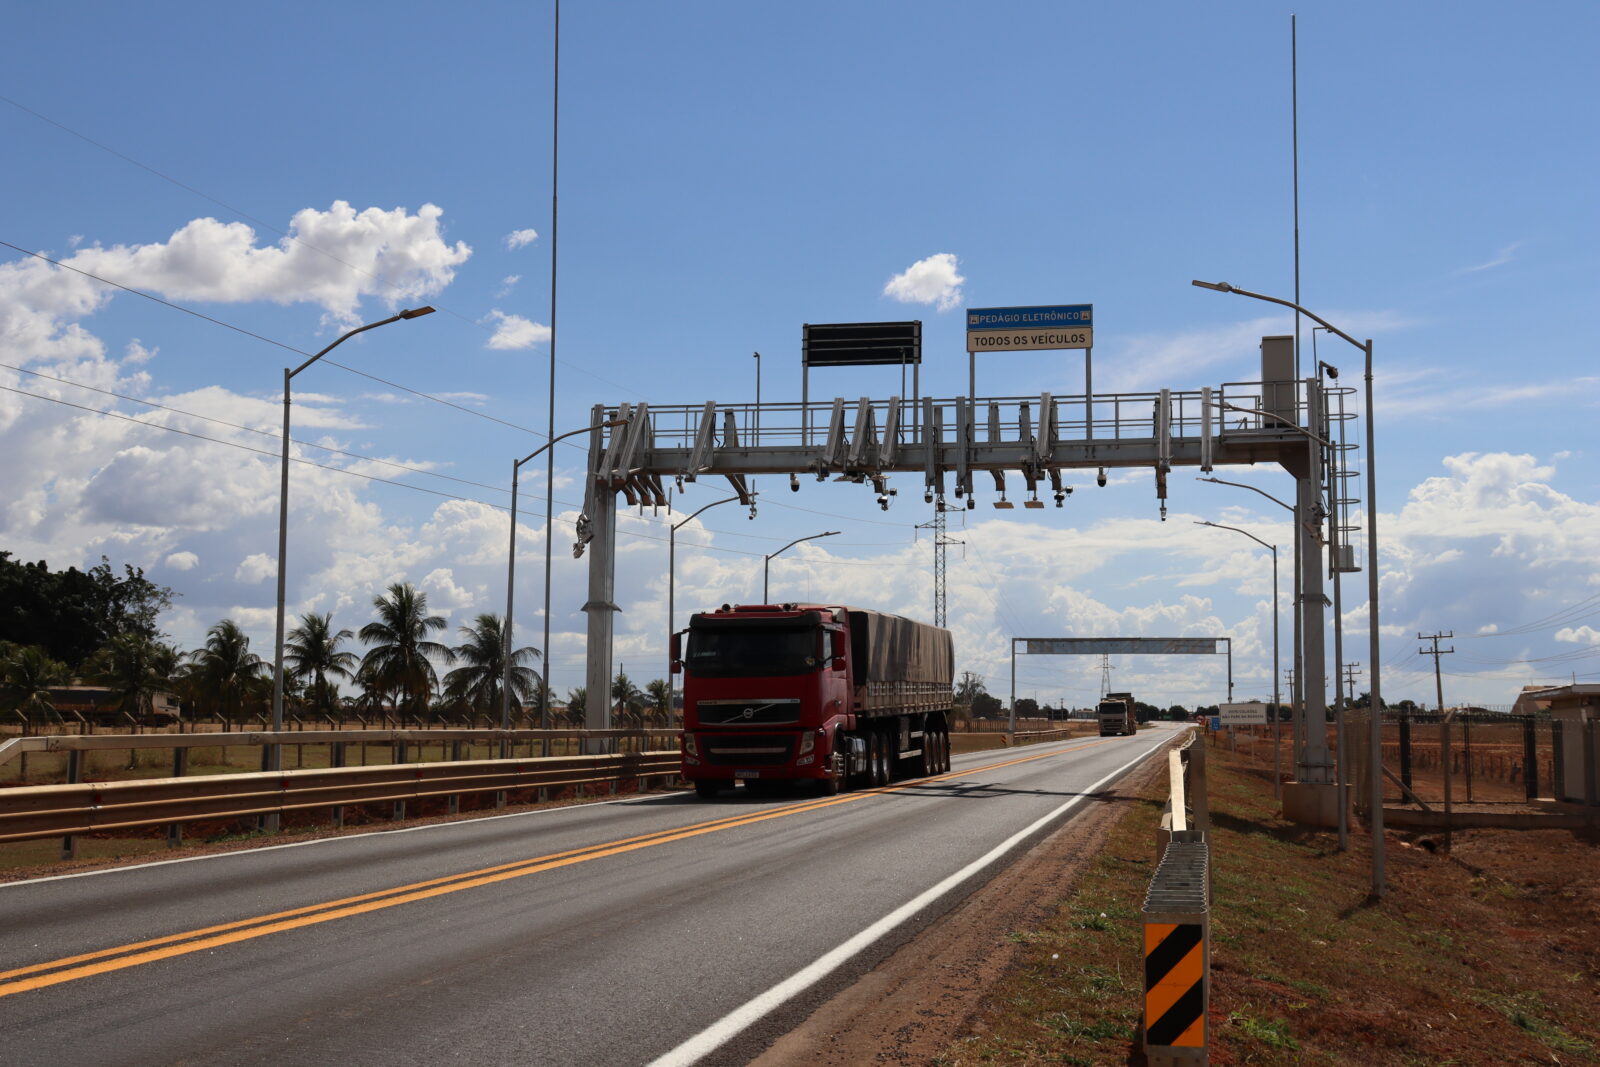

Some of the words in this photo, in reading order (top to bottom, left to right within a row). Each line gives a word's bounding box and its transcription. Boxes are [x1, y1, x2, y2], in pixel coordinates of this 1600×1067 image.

[980, 312, 1020, 323] PEDÁGIO
[1023, 310, 1079, 322] ELETRÔNICO
[974, 337, 1010, 346] TODOS
[1013, 336, 1028, 345] OS
[1031, 333, 1086, 345] VEÍCULOS
